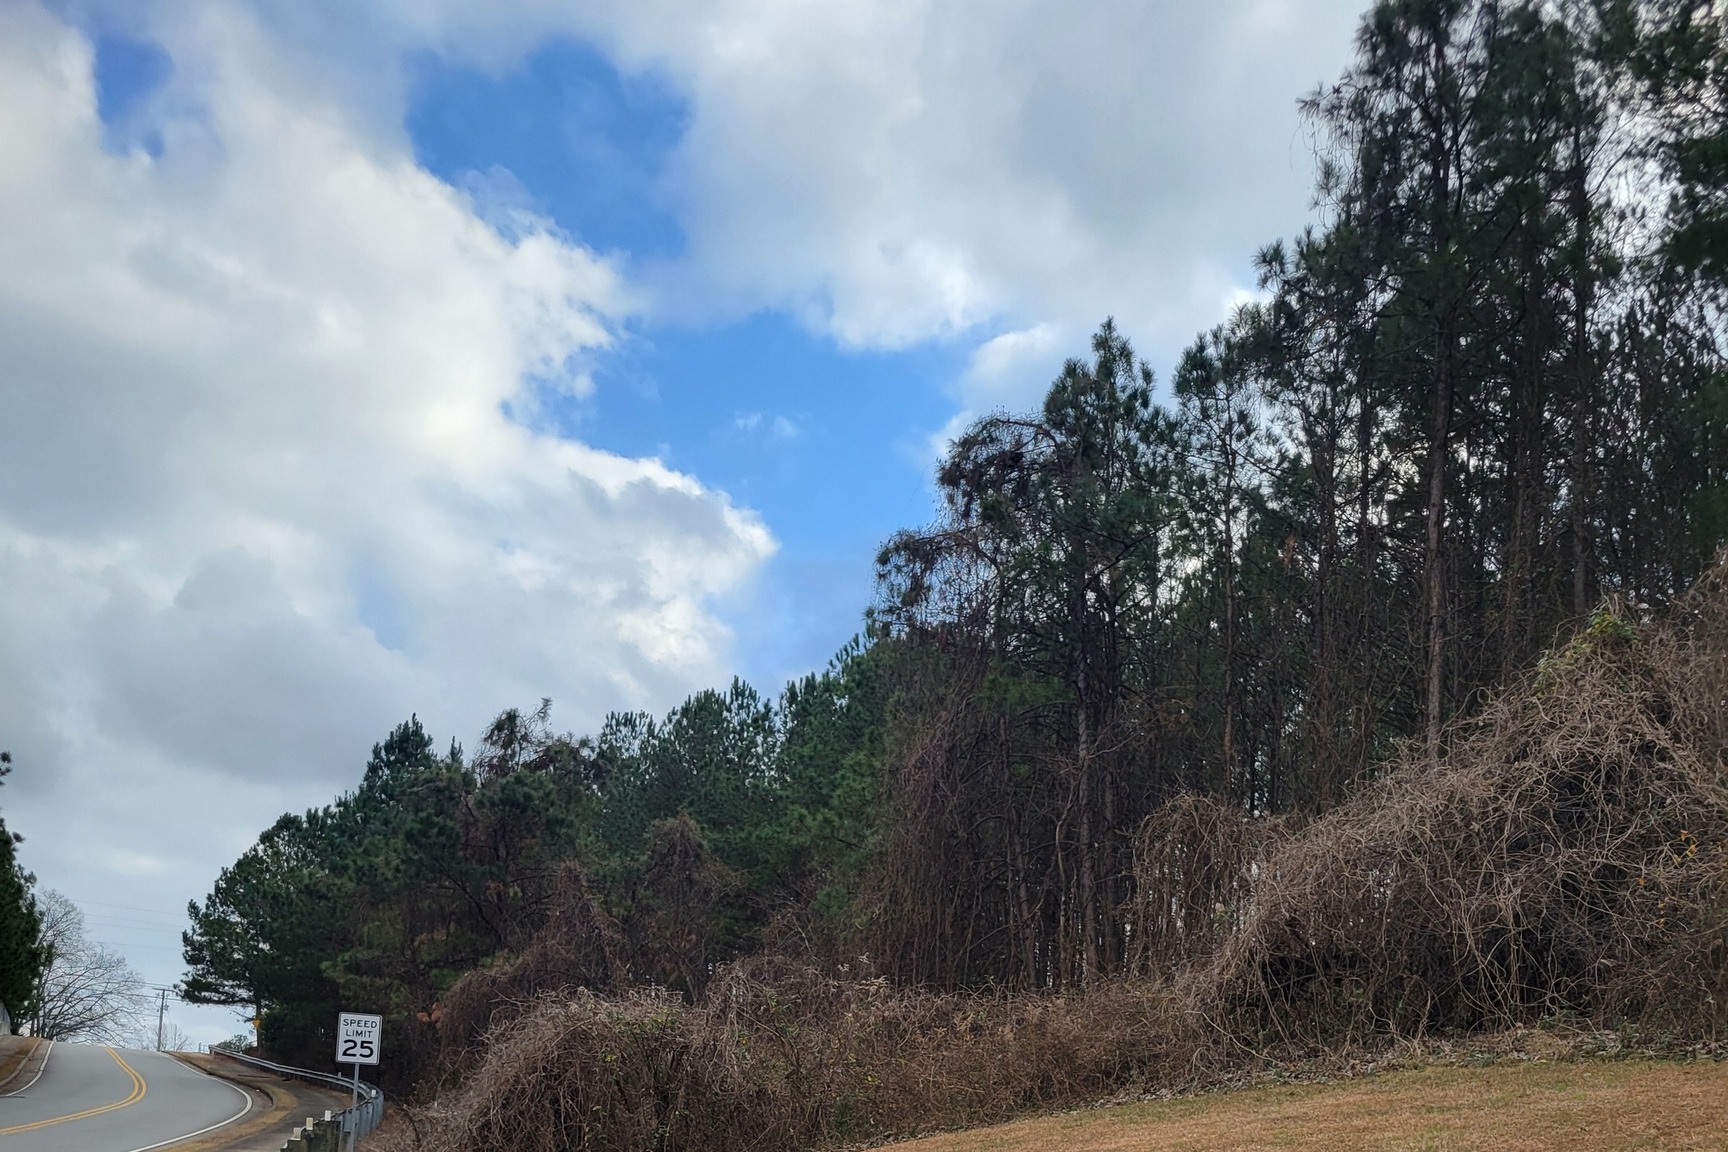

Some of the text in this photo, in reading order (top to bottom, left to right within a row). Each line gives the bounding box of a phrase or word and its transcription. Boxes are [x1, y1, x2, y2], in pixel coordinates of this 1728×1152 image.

[343, 1018, 378, 1029] SPEED
[345, 1029, 373, 1039] LIMIT
[342, 1039, 374, 1058] 25
